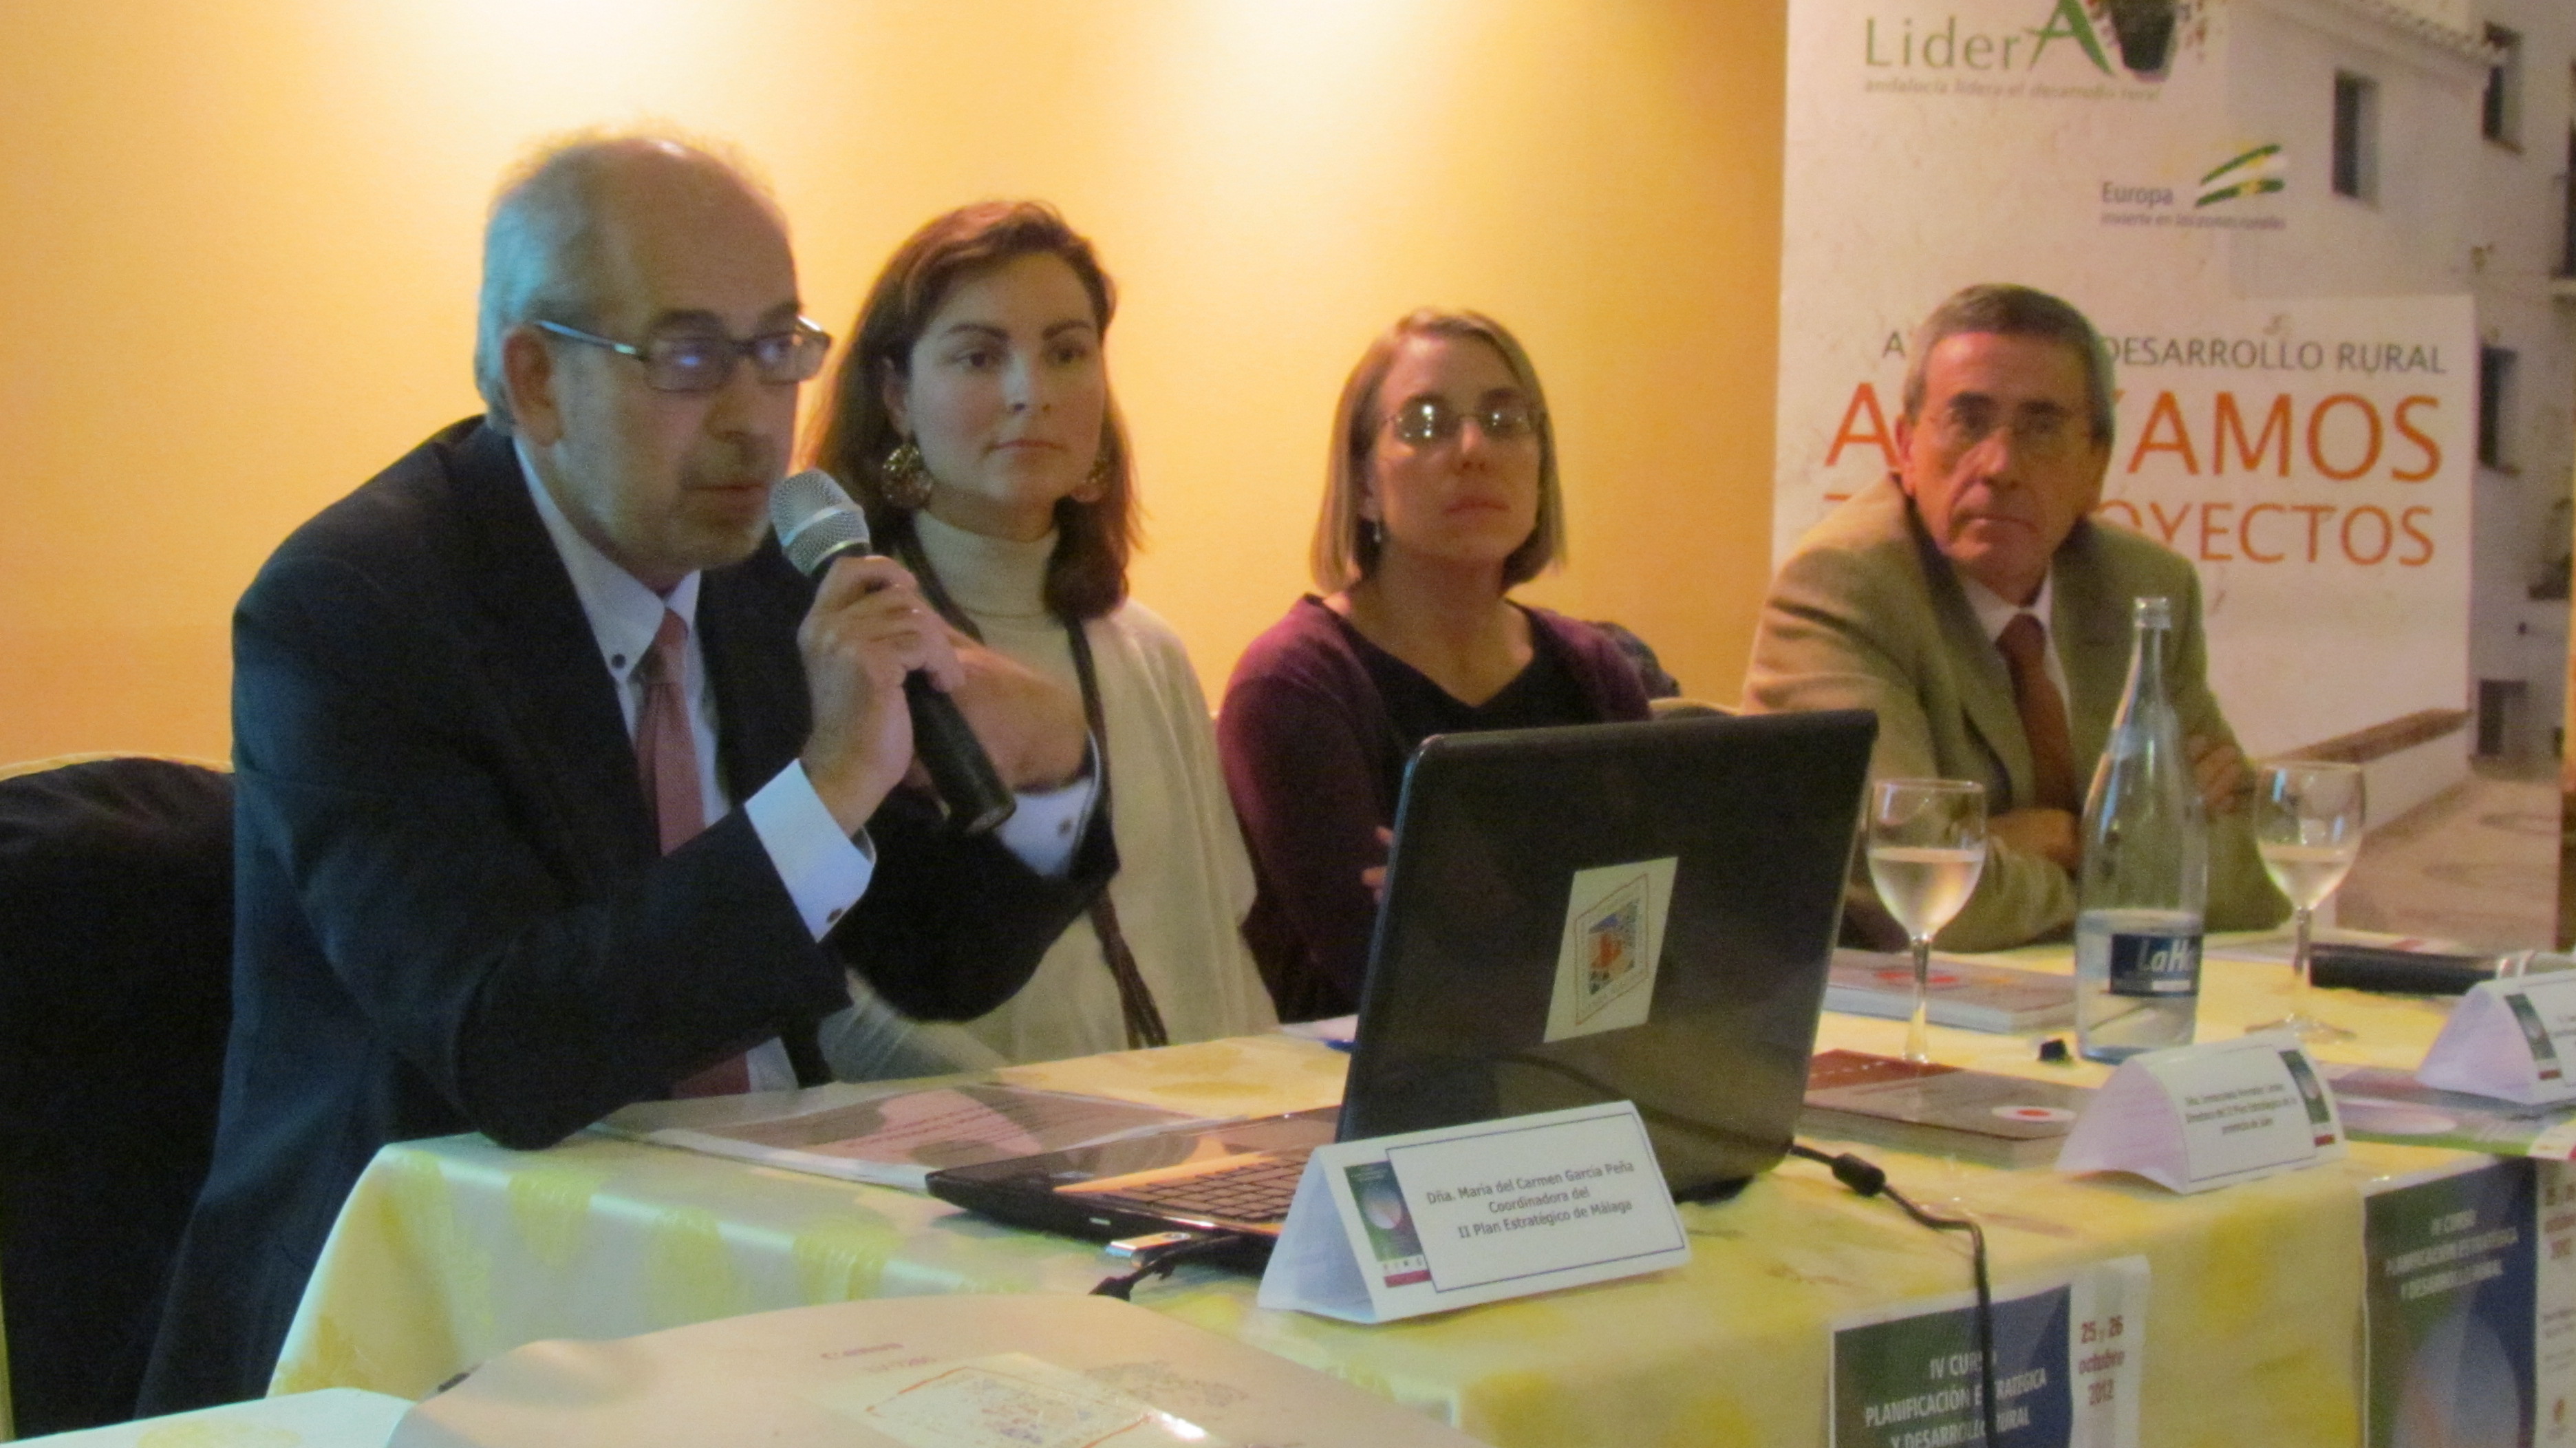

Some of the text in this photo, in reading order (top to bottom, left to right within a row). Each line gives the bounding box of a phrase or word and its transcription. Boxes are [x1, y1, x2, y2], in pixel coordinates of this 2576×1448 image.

[2102, 181, 2174, 209] Europa
[2338, 342, 2447, 374] RURAL
[1496, 1178, 1514, 1193] del
[1516, 1173, 1563, 1190] Carmen
[1604, 1160, 1635, 1175] Peña
[1489, 1186, 1590, 1213] Coordinadora del
[1457, 1199, 1633, 1239] II Plan Estratégico de Málaga
[1929, 1350, 1997, 1379] IV CURS
[1865, 1384, 1971, 1427] PLANIFICACIÓN
